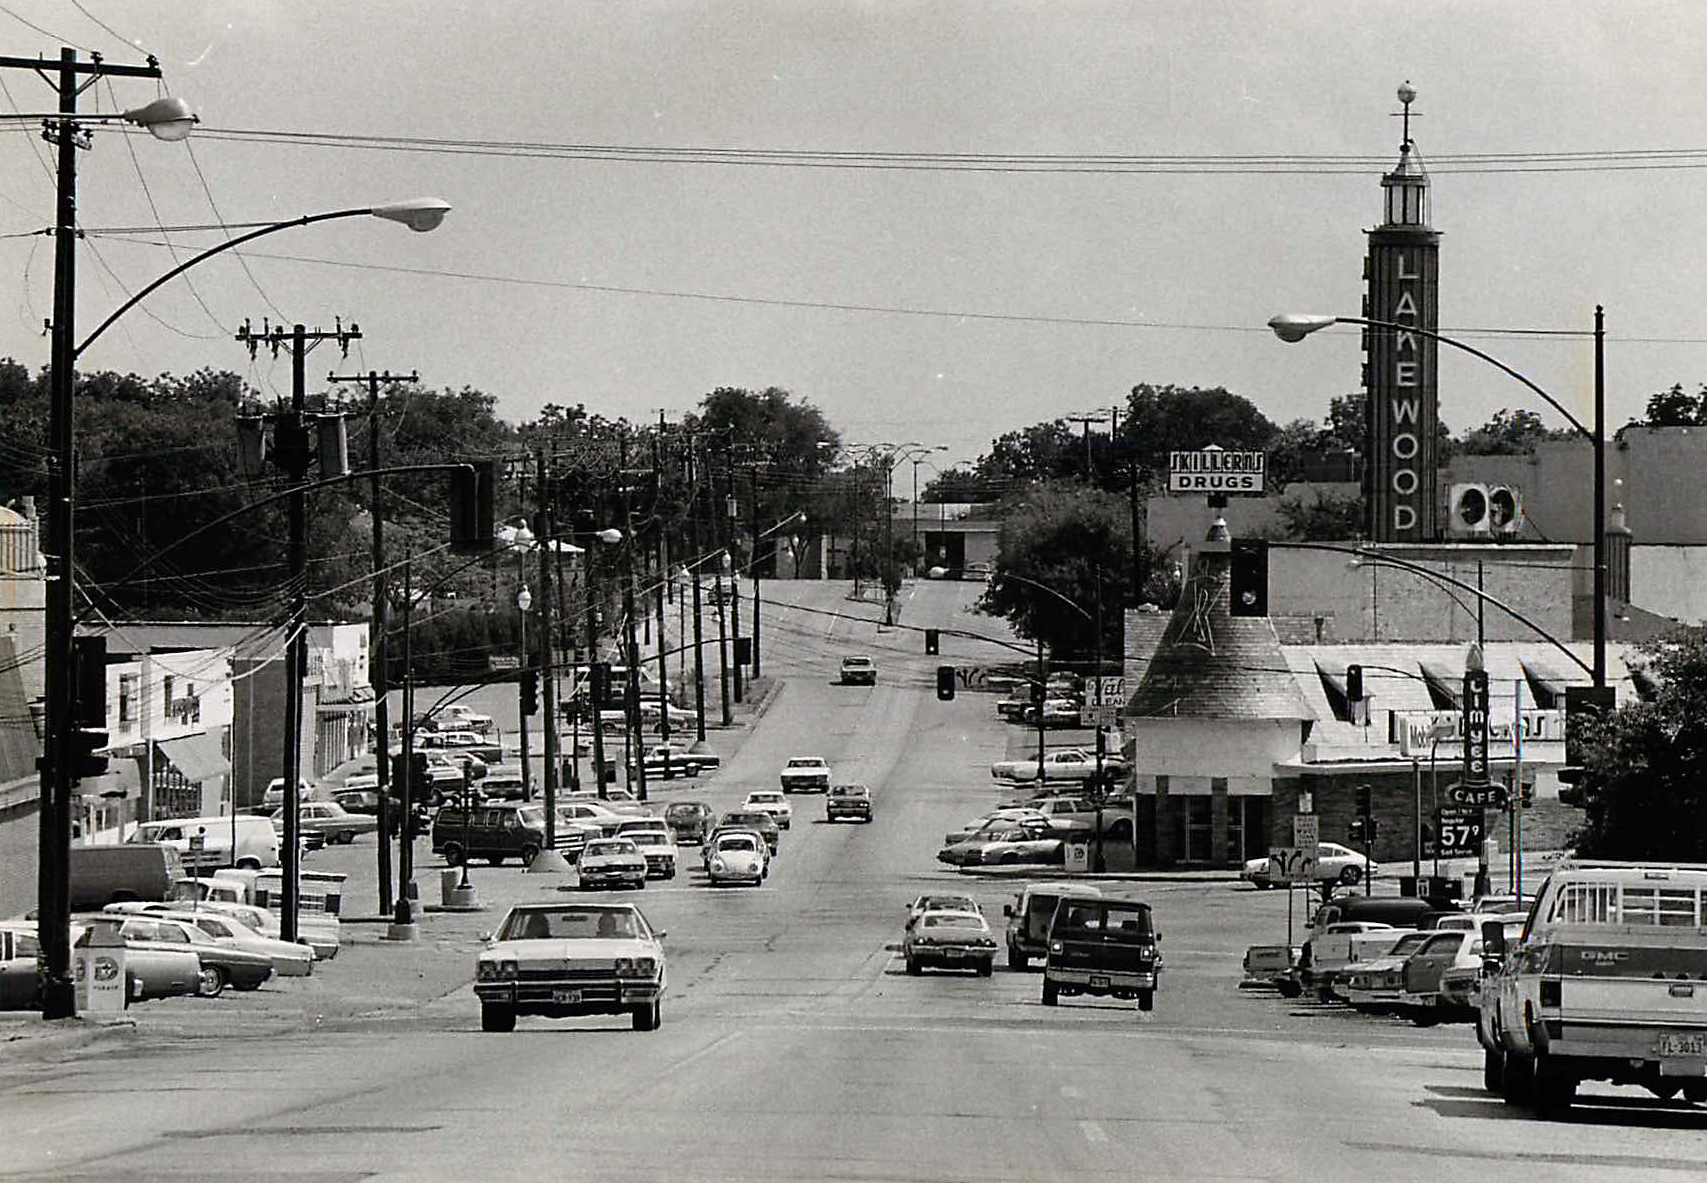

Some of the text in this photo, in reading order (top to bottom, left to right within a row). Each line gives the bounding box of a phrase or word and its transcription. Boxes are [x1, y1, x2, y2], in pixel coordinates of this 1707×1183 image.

[1392, 254, 1420, 530] LAKEWOOD
[1178, 476, 1254, 488] DRUGS
[1454, 790, 1496, 804] CAFE
